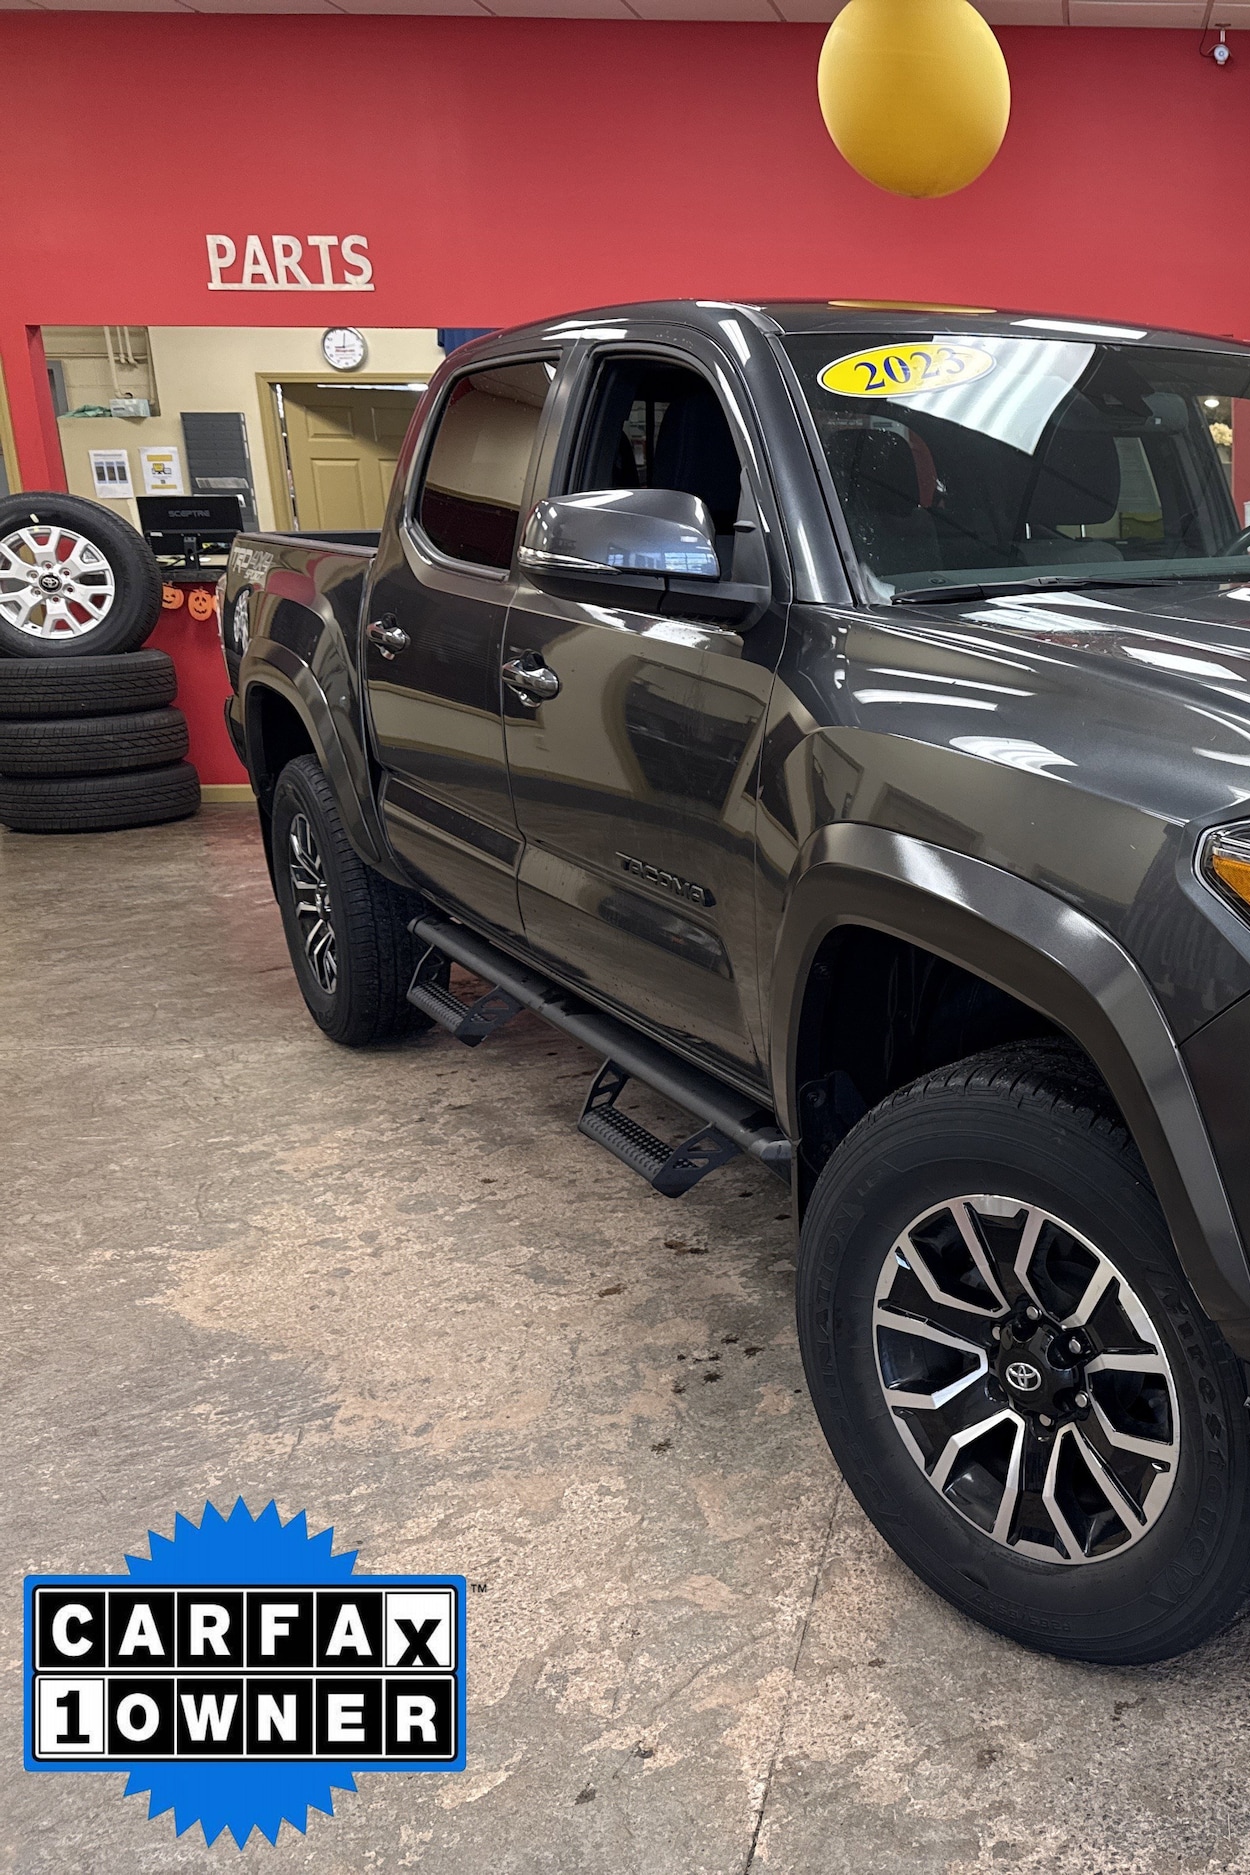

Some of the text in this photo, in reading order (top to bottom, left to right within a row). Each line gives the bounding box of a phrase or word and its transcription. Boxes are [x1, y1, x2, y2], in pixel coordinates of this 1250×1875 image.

[206, 234, 374, 286] PARTS
[854, 347, 965, 391] 2023
[168, 510, 211, 518] SCEPTRE
